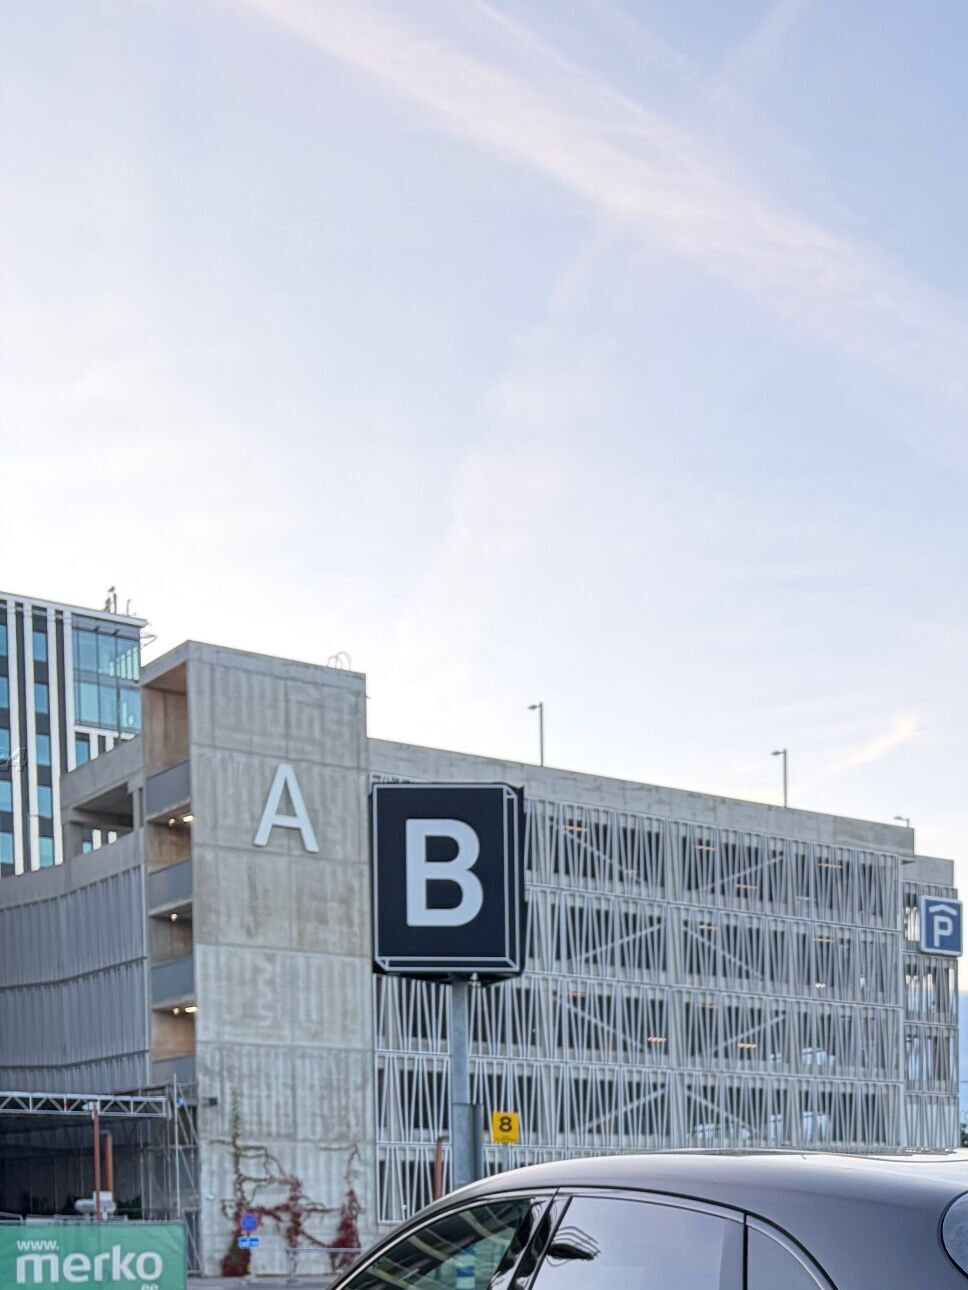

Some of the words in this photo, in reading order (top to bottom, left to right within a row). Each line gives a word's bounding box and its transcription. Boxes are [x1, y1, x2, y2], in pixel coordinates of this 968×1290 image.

[254, 763, 319, 853] A
[405, 818, 484, 927] B
[933, 915, 953, 947] P
[498, 1116, 512, 1132] 8
[16, 1239, 60, 1251] www.
[16, 1244, 164, 1284] merko
